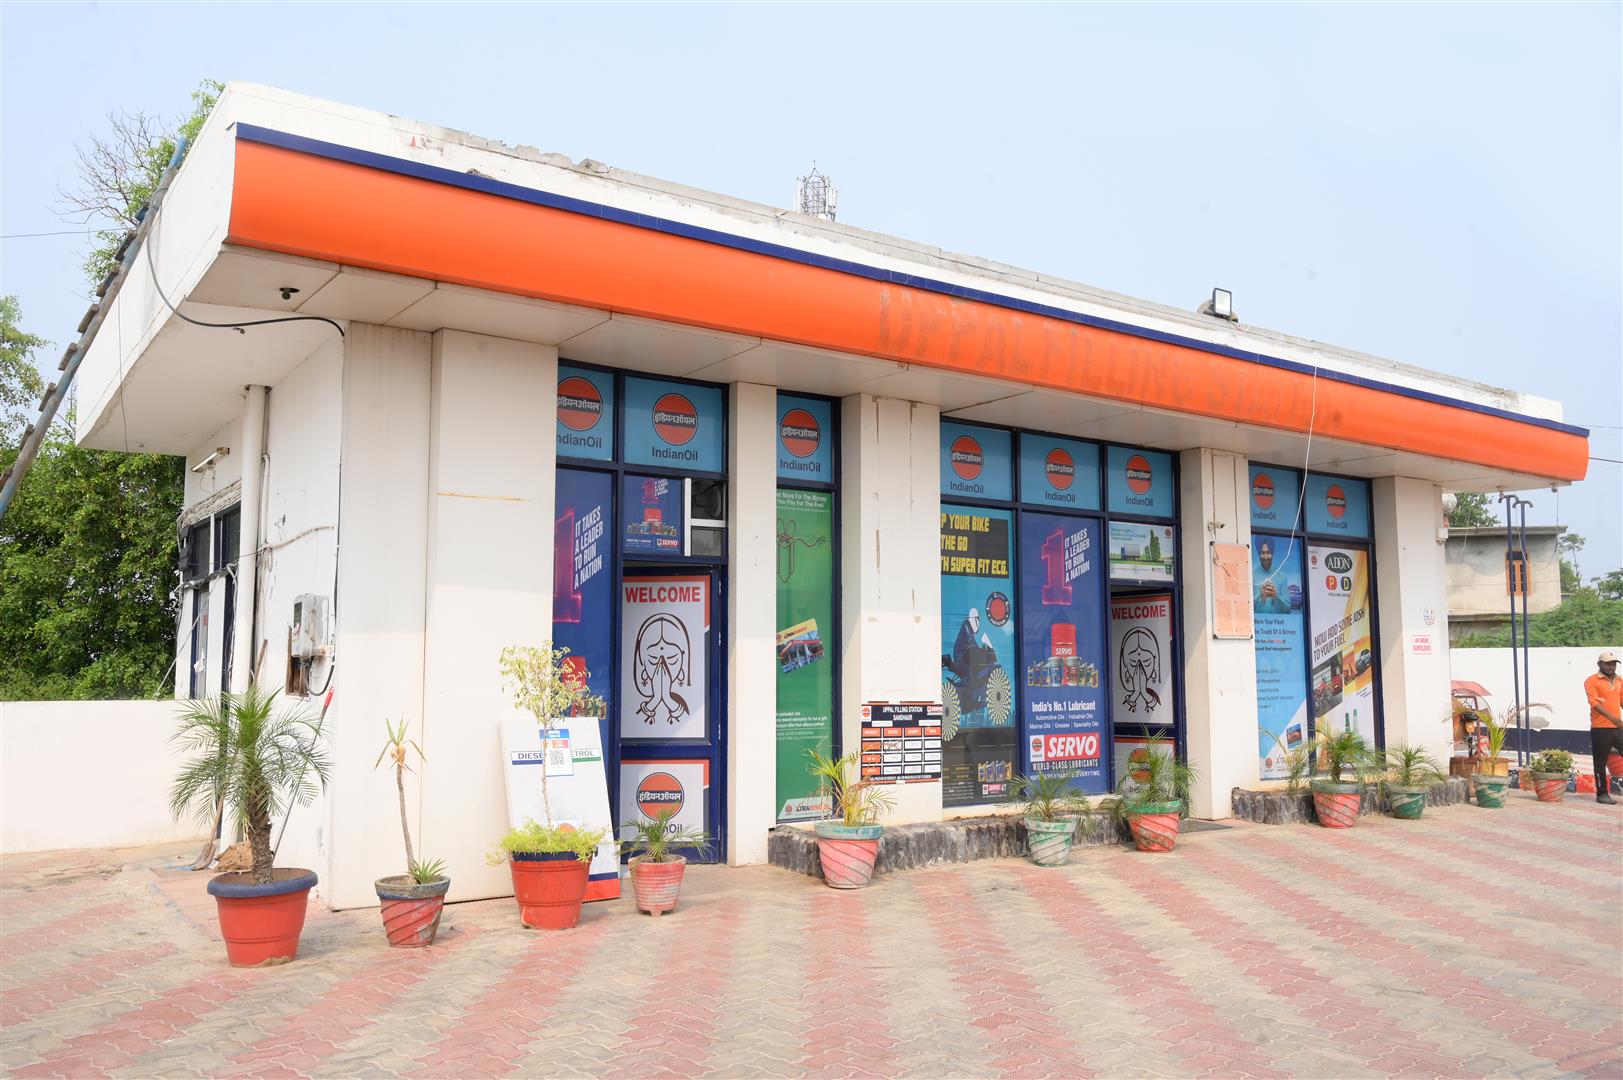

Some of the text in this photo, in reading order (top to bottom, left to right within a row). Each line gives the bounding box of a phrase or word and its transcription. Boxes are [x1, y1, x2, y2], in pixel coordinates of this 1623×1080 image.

[557, 434, 602, 448] ndianOil
[652, 447, 698, 461] IndianOil
[780, 459, 820, 472] IndianOil
[950, 482, 984, 494] IndianOil
[1045, 491, 1076, 503] IndianOil
[1126, 495, 1153, 506] IndianOil
[576, 505, 600, 538] IT TAKES
[949, 513, 970, 531] YOUR
[971, 516, 990, 532] BIKE
[575, 520, 603, 555] A LEADER
[941, 535, 968, 552] THE GO
[1065, 528, 1087, 549] IT TAKES
[575, 541, 597, 572] TO RUN
[1065, 538, 1090, 560] A LEADER
[951, 556, 976, 574] SUPER
[978, 559, 990, 575] FIT
[1065, 552, 1084, 572] TO RUN
[1327, 556, 1350, 570] ADON
[575, 554, 602, 590] A NATION
[1065, 560, 1090, 583] A NATION
[1329, 577, 1349, 590] P D
[625, 586, 701, 603] WELCOME
[1111, 604, 1167, 620] WELCOME
[1315, 630, 1327, 648] NOW
[1328, 623, 1338, 640] ADD
[1313, 633, 1345, 662] TO YOUR FUEL
[1032, 700, 1096, 712] India's No.1 Lubricant
[518, 749, 594, 760] DIESE ETROL
[1047, 735, 1097, 758] SERVO
[1032, 758, 1098, 771] WORLD-CLASS LUBRICANTS
